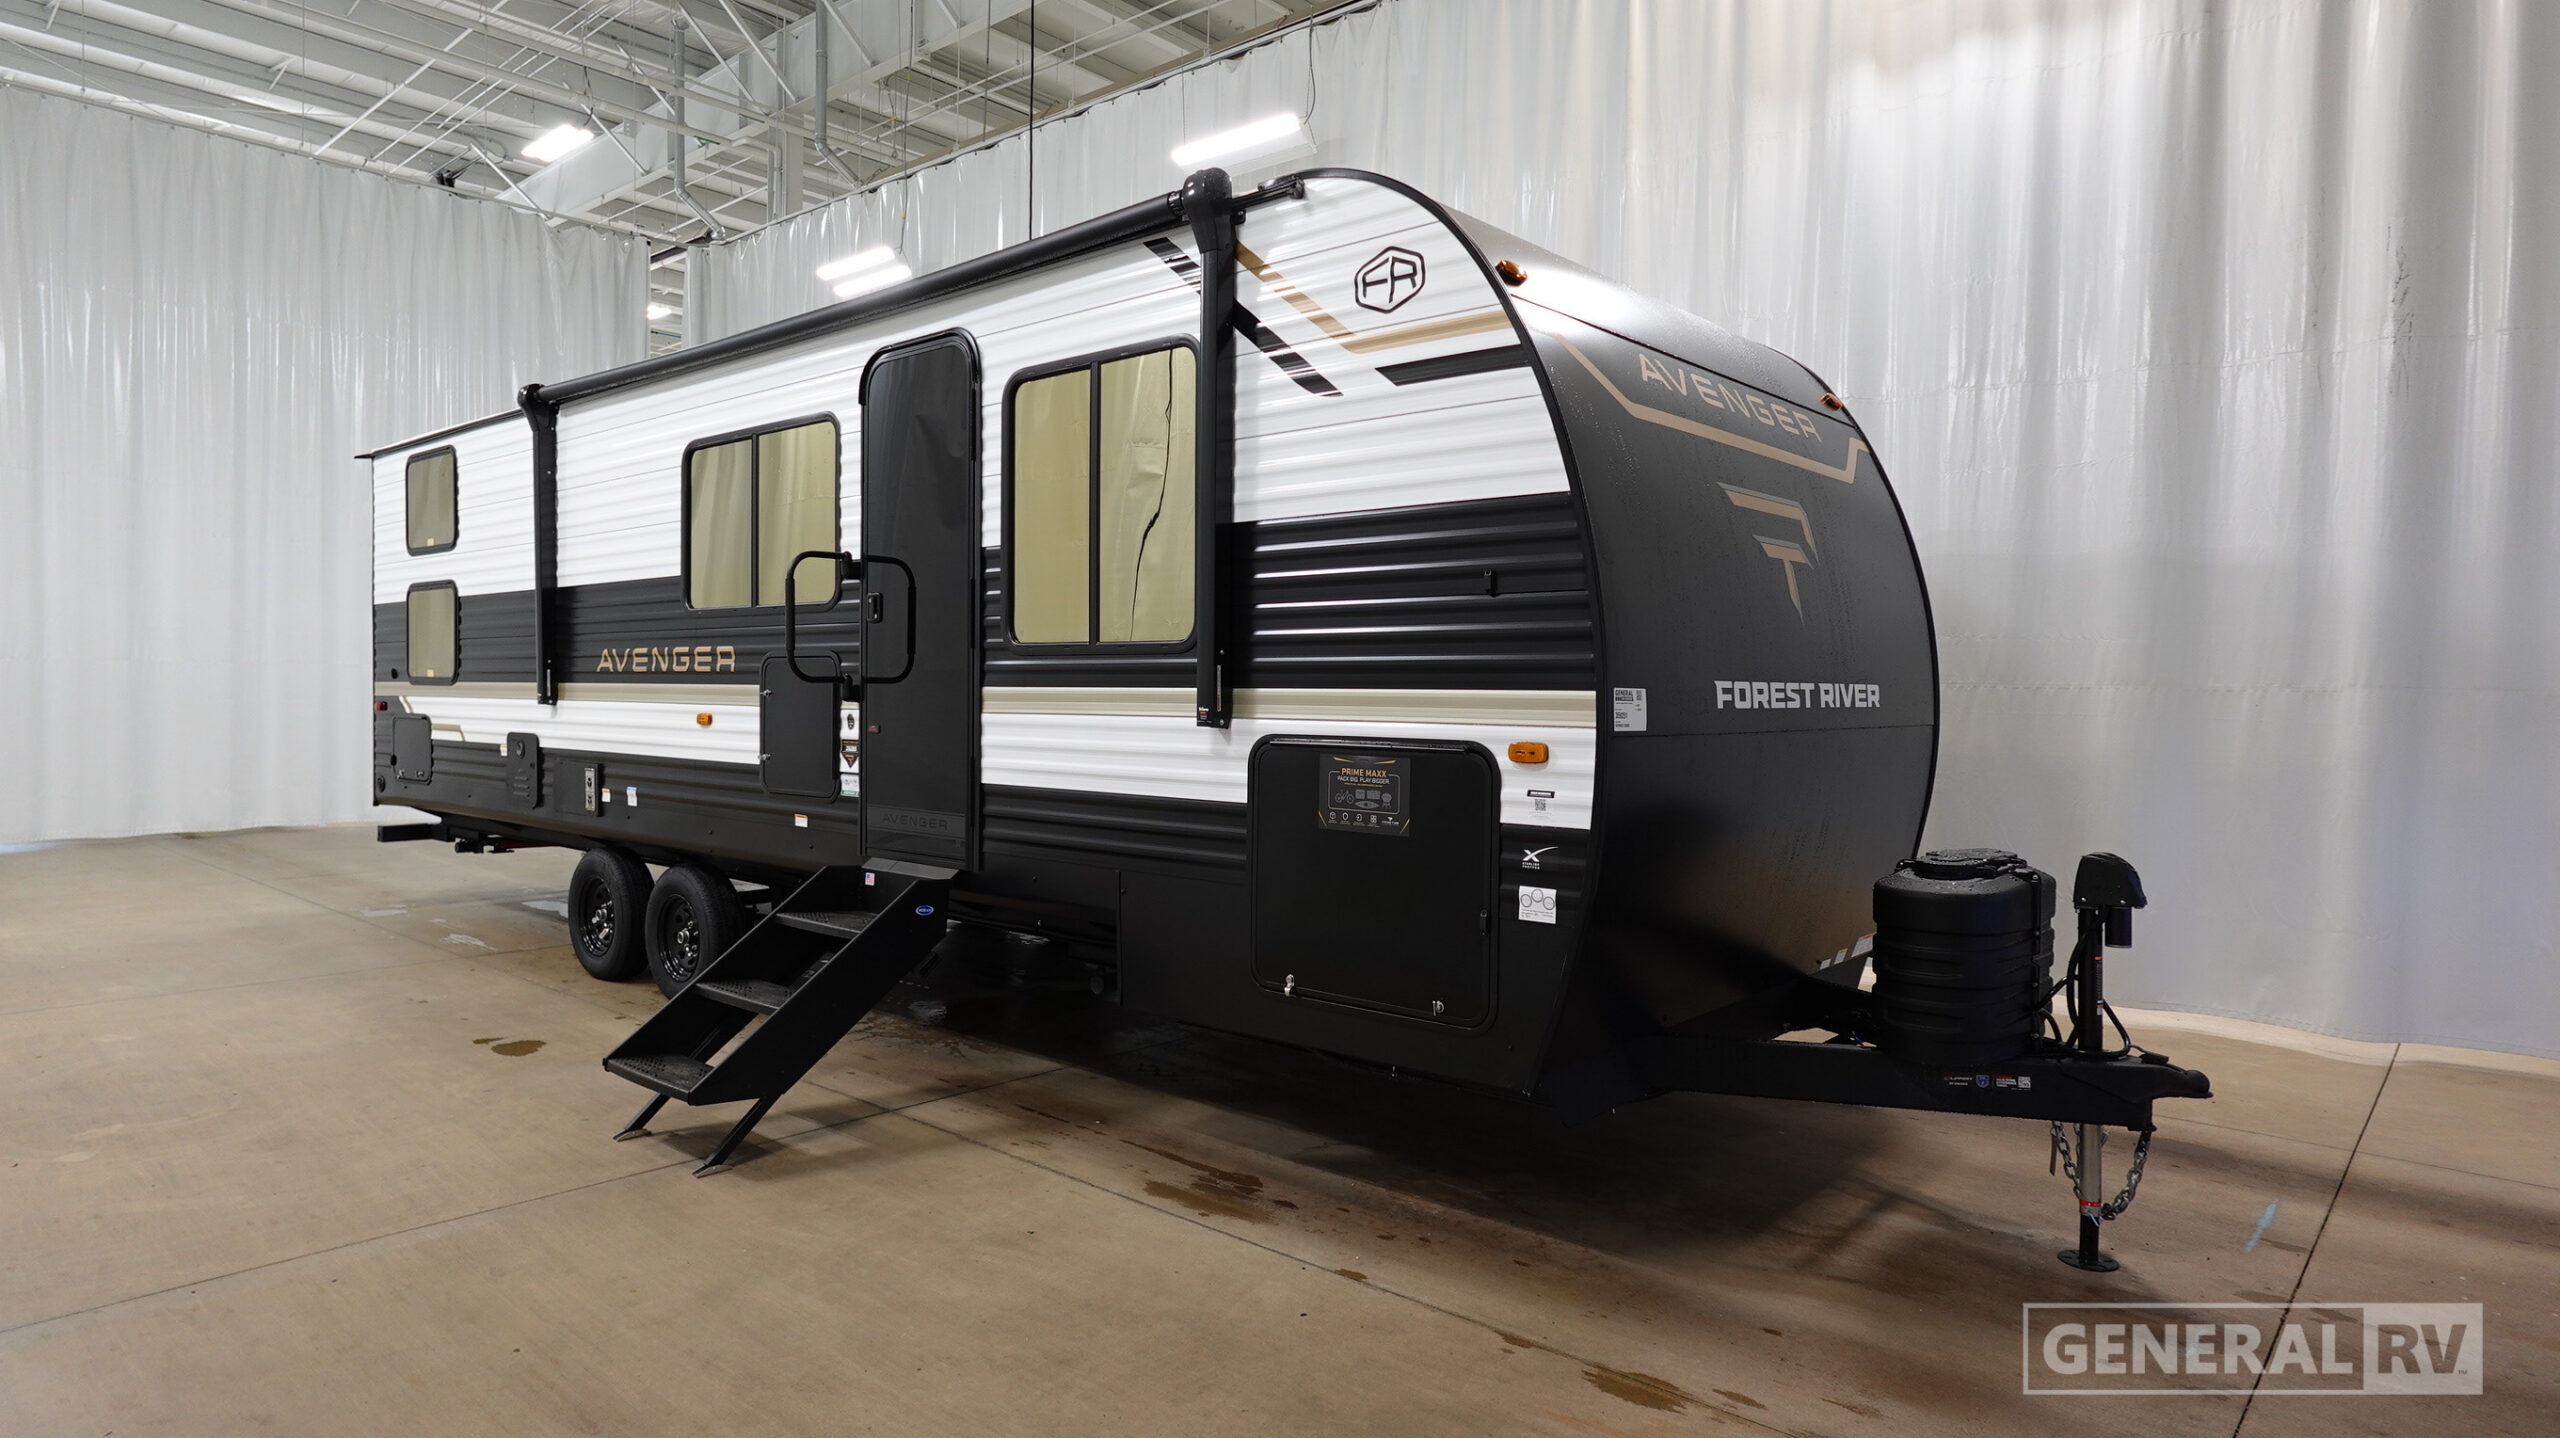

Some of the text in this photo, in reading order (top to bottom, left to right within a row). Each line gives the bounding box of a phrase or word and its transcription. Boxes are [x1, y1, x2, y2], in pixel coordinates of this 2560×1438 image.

[1638, 353, 1822, 443] AVENGER
[596, 646, 736, 672] AVENGER
[1714, 680, 1881, 709] FOREST RIVER
[1341, 767, 1387, 777] PRIME MAXX
[882, 813, 949, 832] AVENGER
